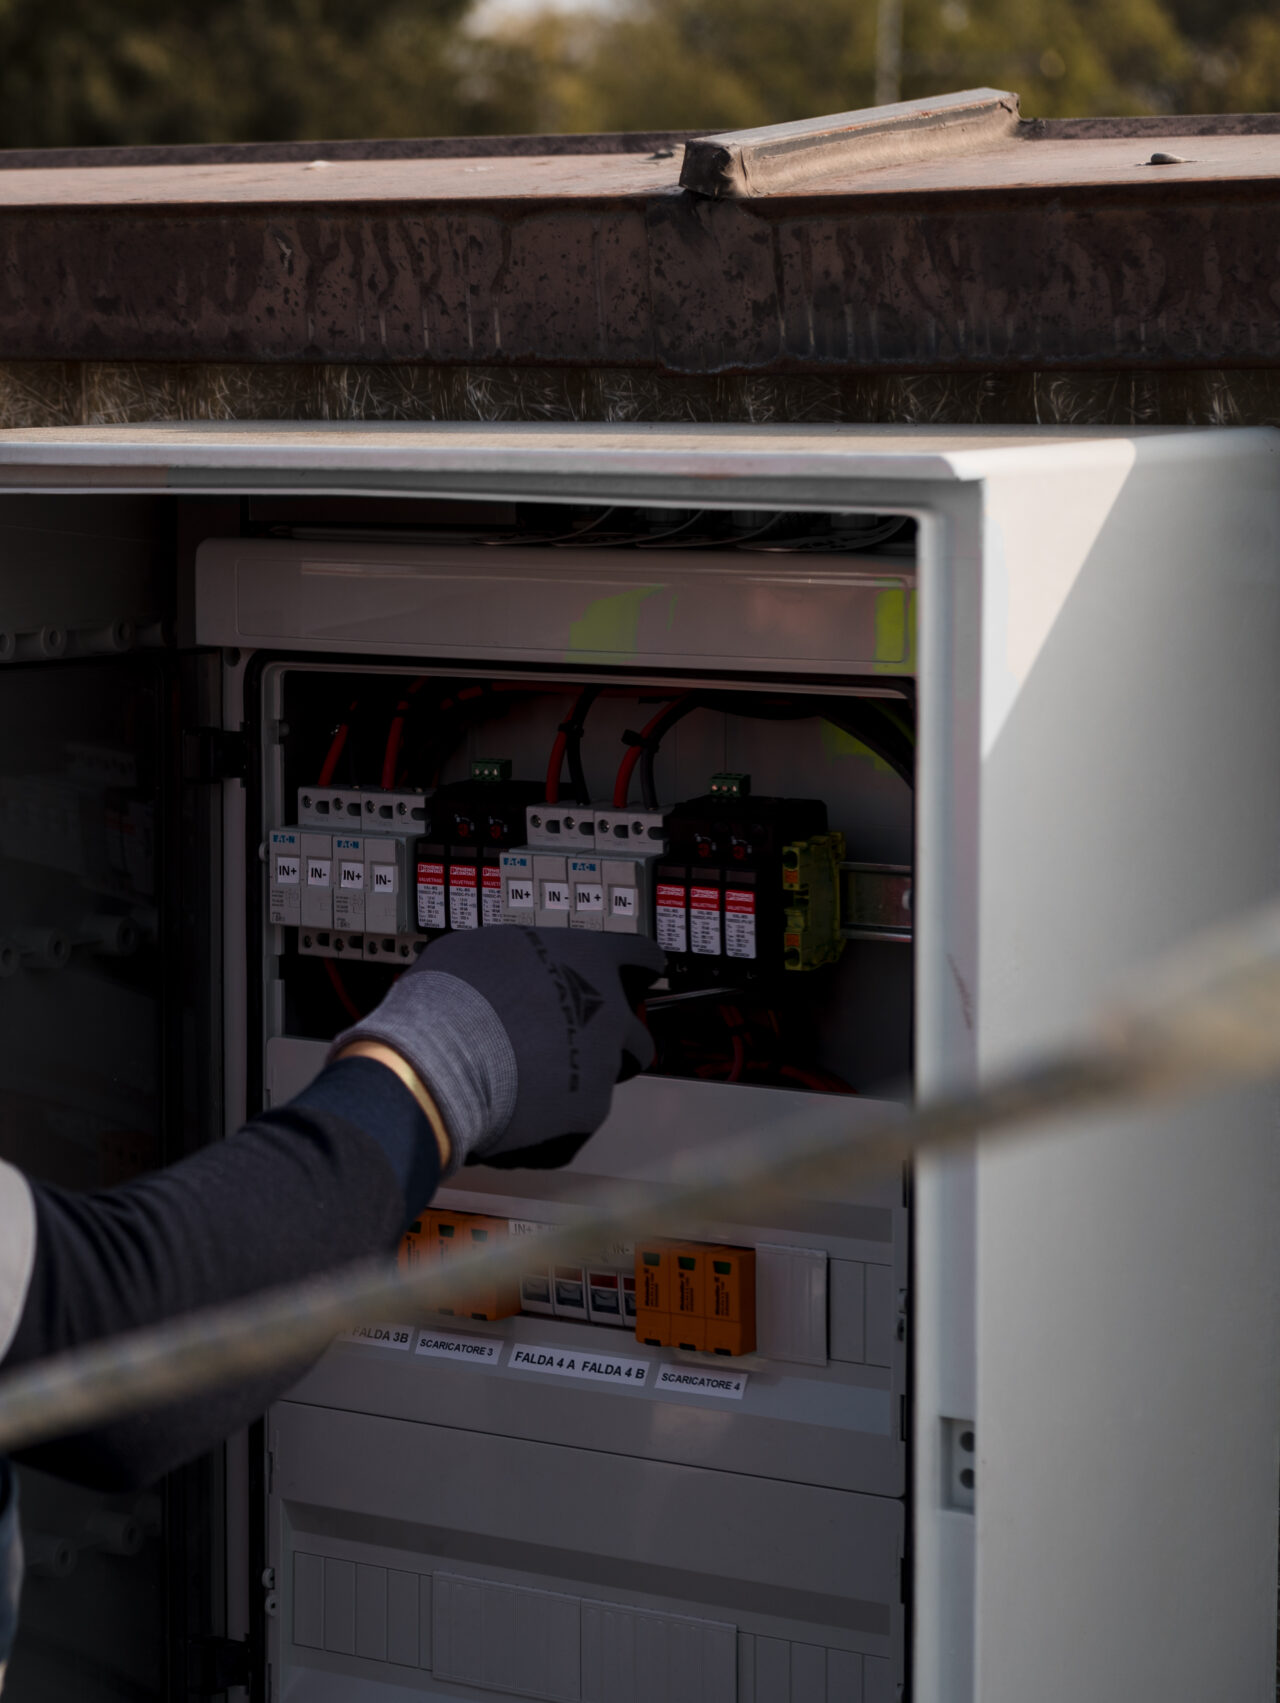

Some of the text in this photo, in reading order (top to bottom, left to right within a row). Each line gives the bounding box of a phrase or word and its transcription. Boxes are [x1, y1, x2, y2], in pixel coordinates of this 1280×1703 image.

[279, 865, 297, 876] IN+
[311, 867, 327, 878] IN-
[343, 869, 362, 881] IN+
[375, 874, 392, 885] IN-
[511, 888, 531, 900] IN+
[614, 895, 632, 907] IN-
[352, 1326, 390, 1341] FALDA
[393, 1332, 409, 1344] 3B
[419, 1338, 494, 1357] SCARICATORE 3
[514, 1351, 646, 1380] FALDA 4 A FALDA 4 B
[661, 1372, 741, 1392] SCARICATORE 4
